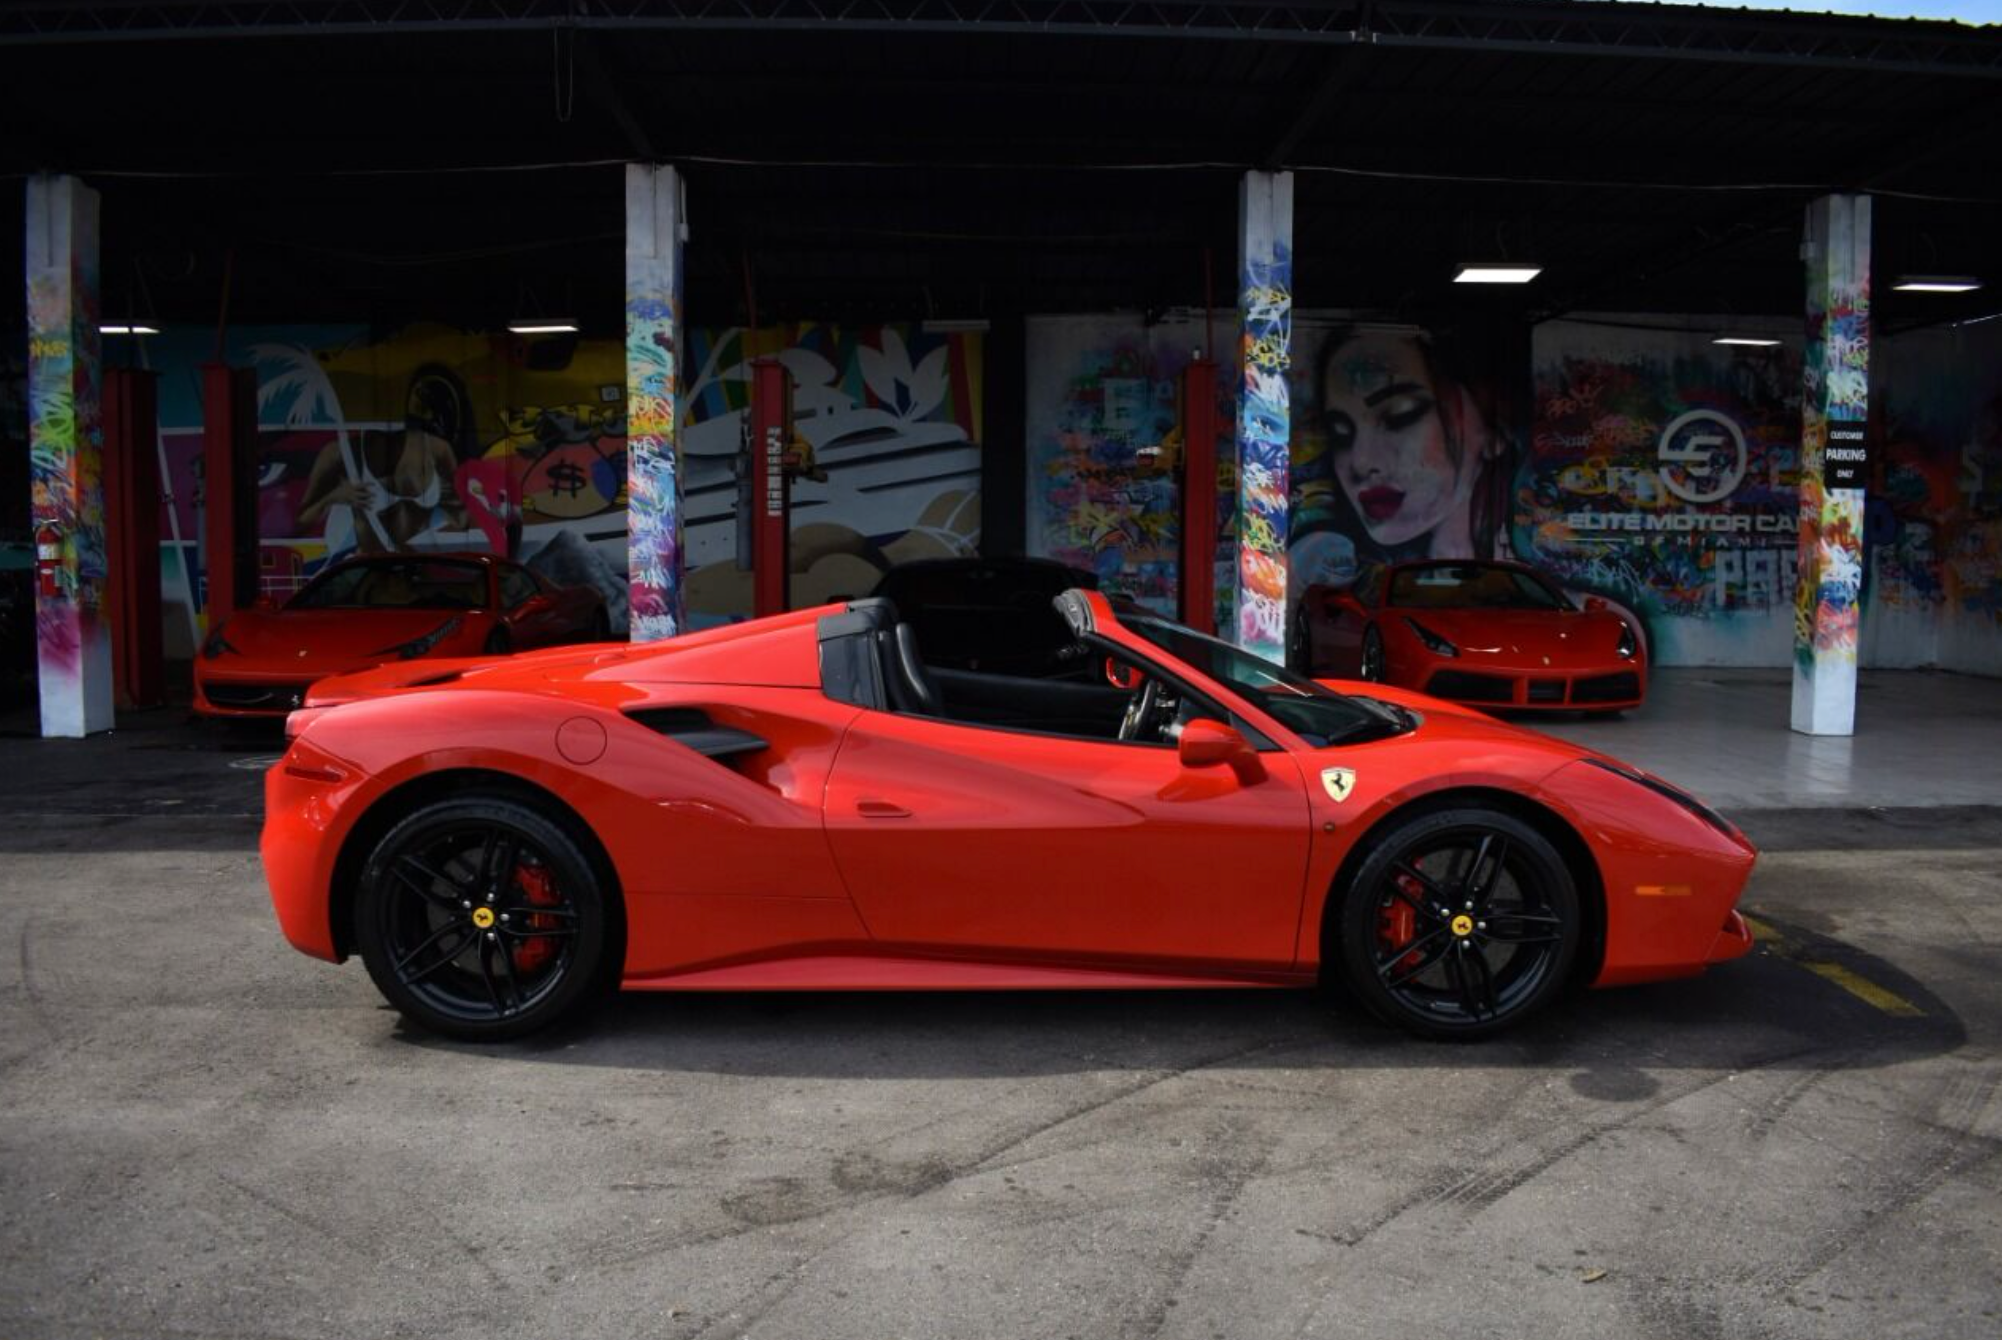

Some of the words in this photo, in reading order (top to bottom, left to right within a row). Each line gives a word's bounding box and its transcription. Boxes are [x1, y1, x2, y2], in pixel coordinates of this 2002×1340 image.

[1830, 431, 1864, 440] CUSTOMER
[1826, 448, 1866, 461] PARKING
[1837, 469, 1854, 478] ONLY
[1568, 512, 1643, 530] ELITE
[1649, 514, 1751, 532] MOTOR
[1756, 514, 1799, 533] CA
[1633, 535, 1665, 546] OF
[1677, 536, 1766, 547] MIAMI
